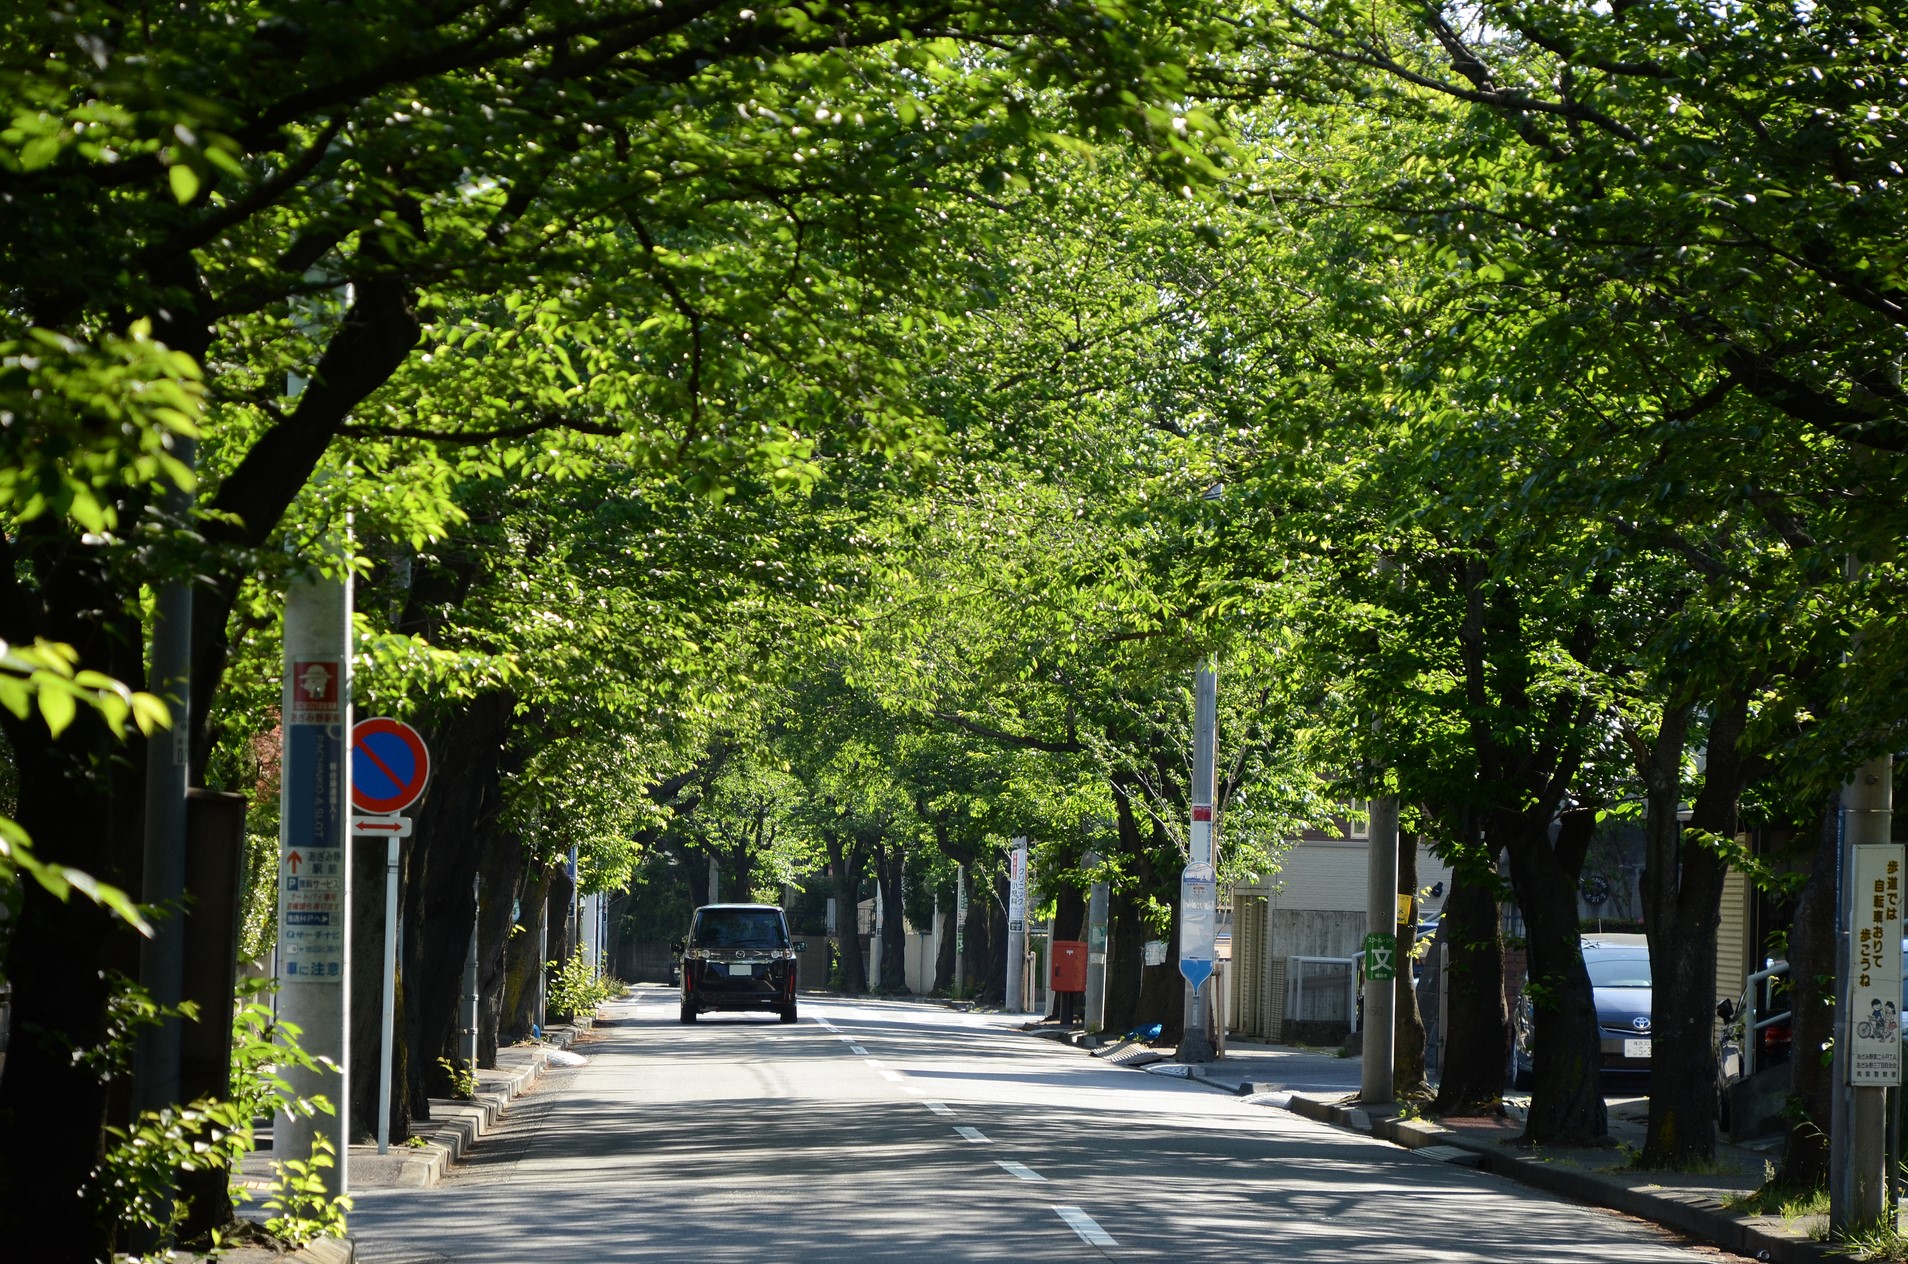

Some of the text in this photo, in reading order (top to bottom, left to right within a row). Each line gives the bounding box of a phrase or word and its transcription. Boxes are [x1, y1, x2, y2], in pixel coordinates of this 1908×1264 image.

[314, 808, 324, 839] SLOT
[1886, 860, 1899, 921] 歩道では
[1872, 879, 1885, 969] 自転車おりて
[286, 961, 340, 977] 車に注意
[1860, 928, 1872, 988] 歩こうね
